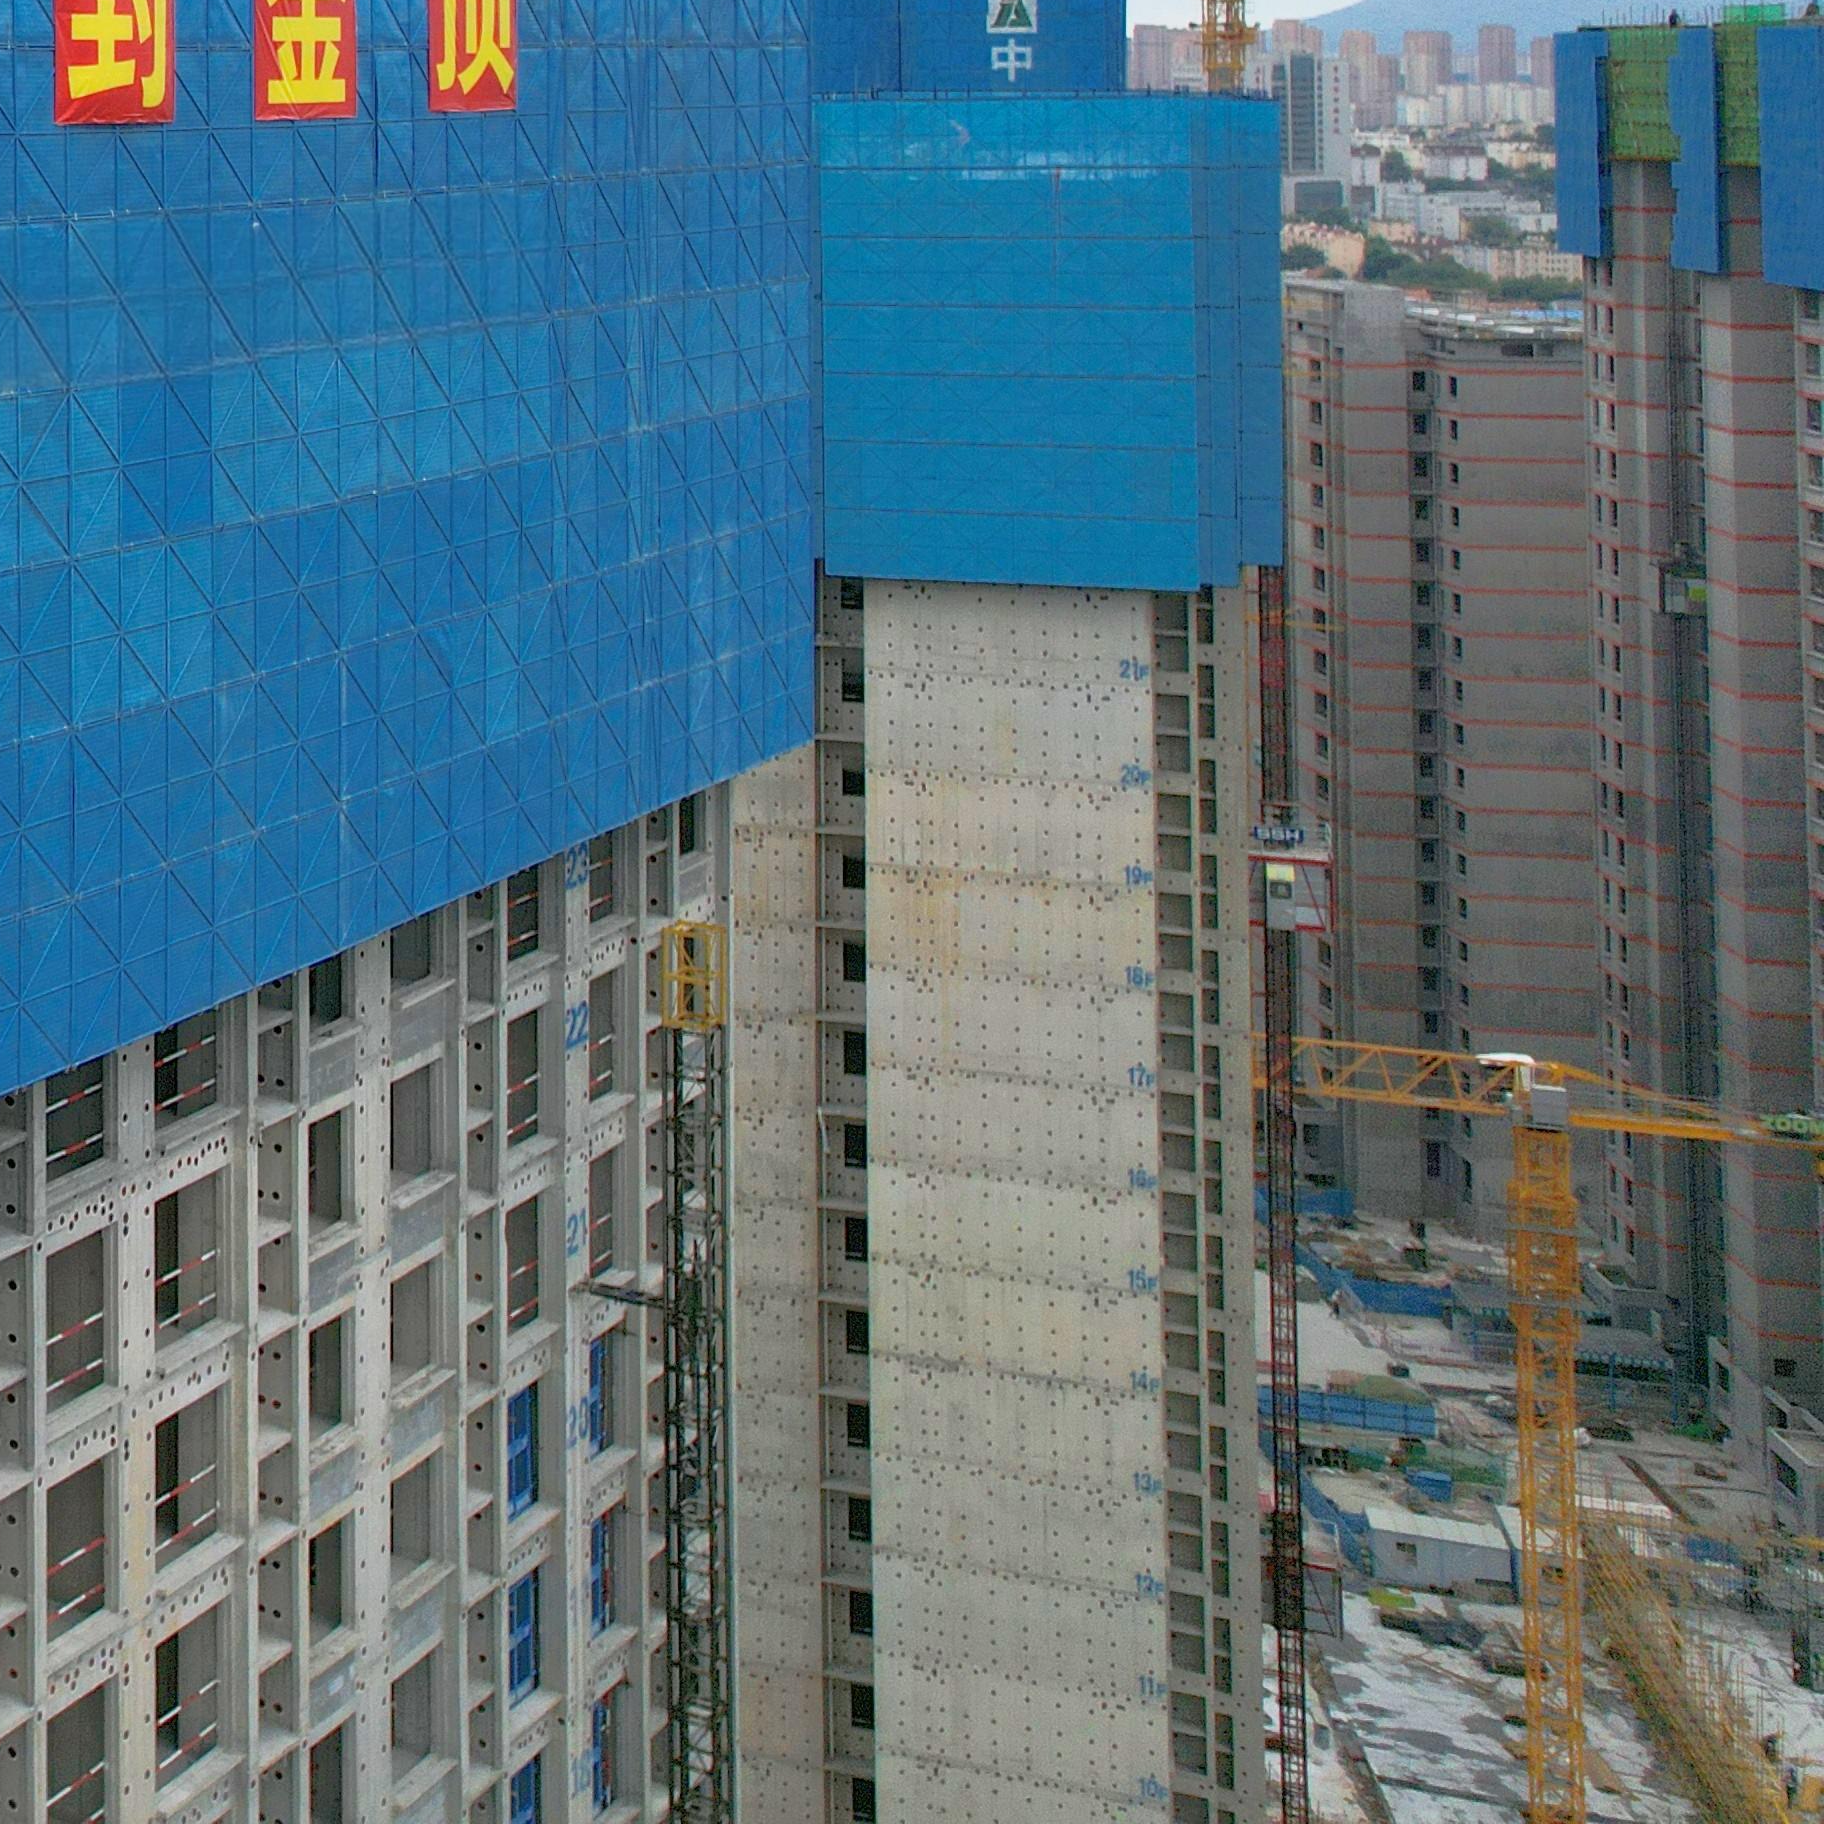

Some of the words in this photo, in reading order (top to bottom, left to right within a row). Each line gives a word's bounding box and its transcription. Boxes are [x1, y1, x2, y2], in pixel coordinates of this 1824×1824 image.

[991, 38, 1032, 82] 中
[1119, 659, 1149, 680] 21F
[1124, 865, 1152, 886] 19F
[565, 1000, 589, 1049] 22
[1128, 1066, 1155, 1087] 17F
[566, 1208, 587, 1257] 21
